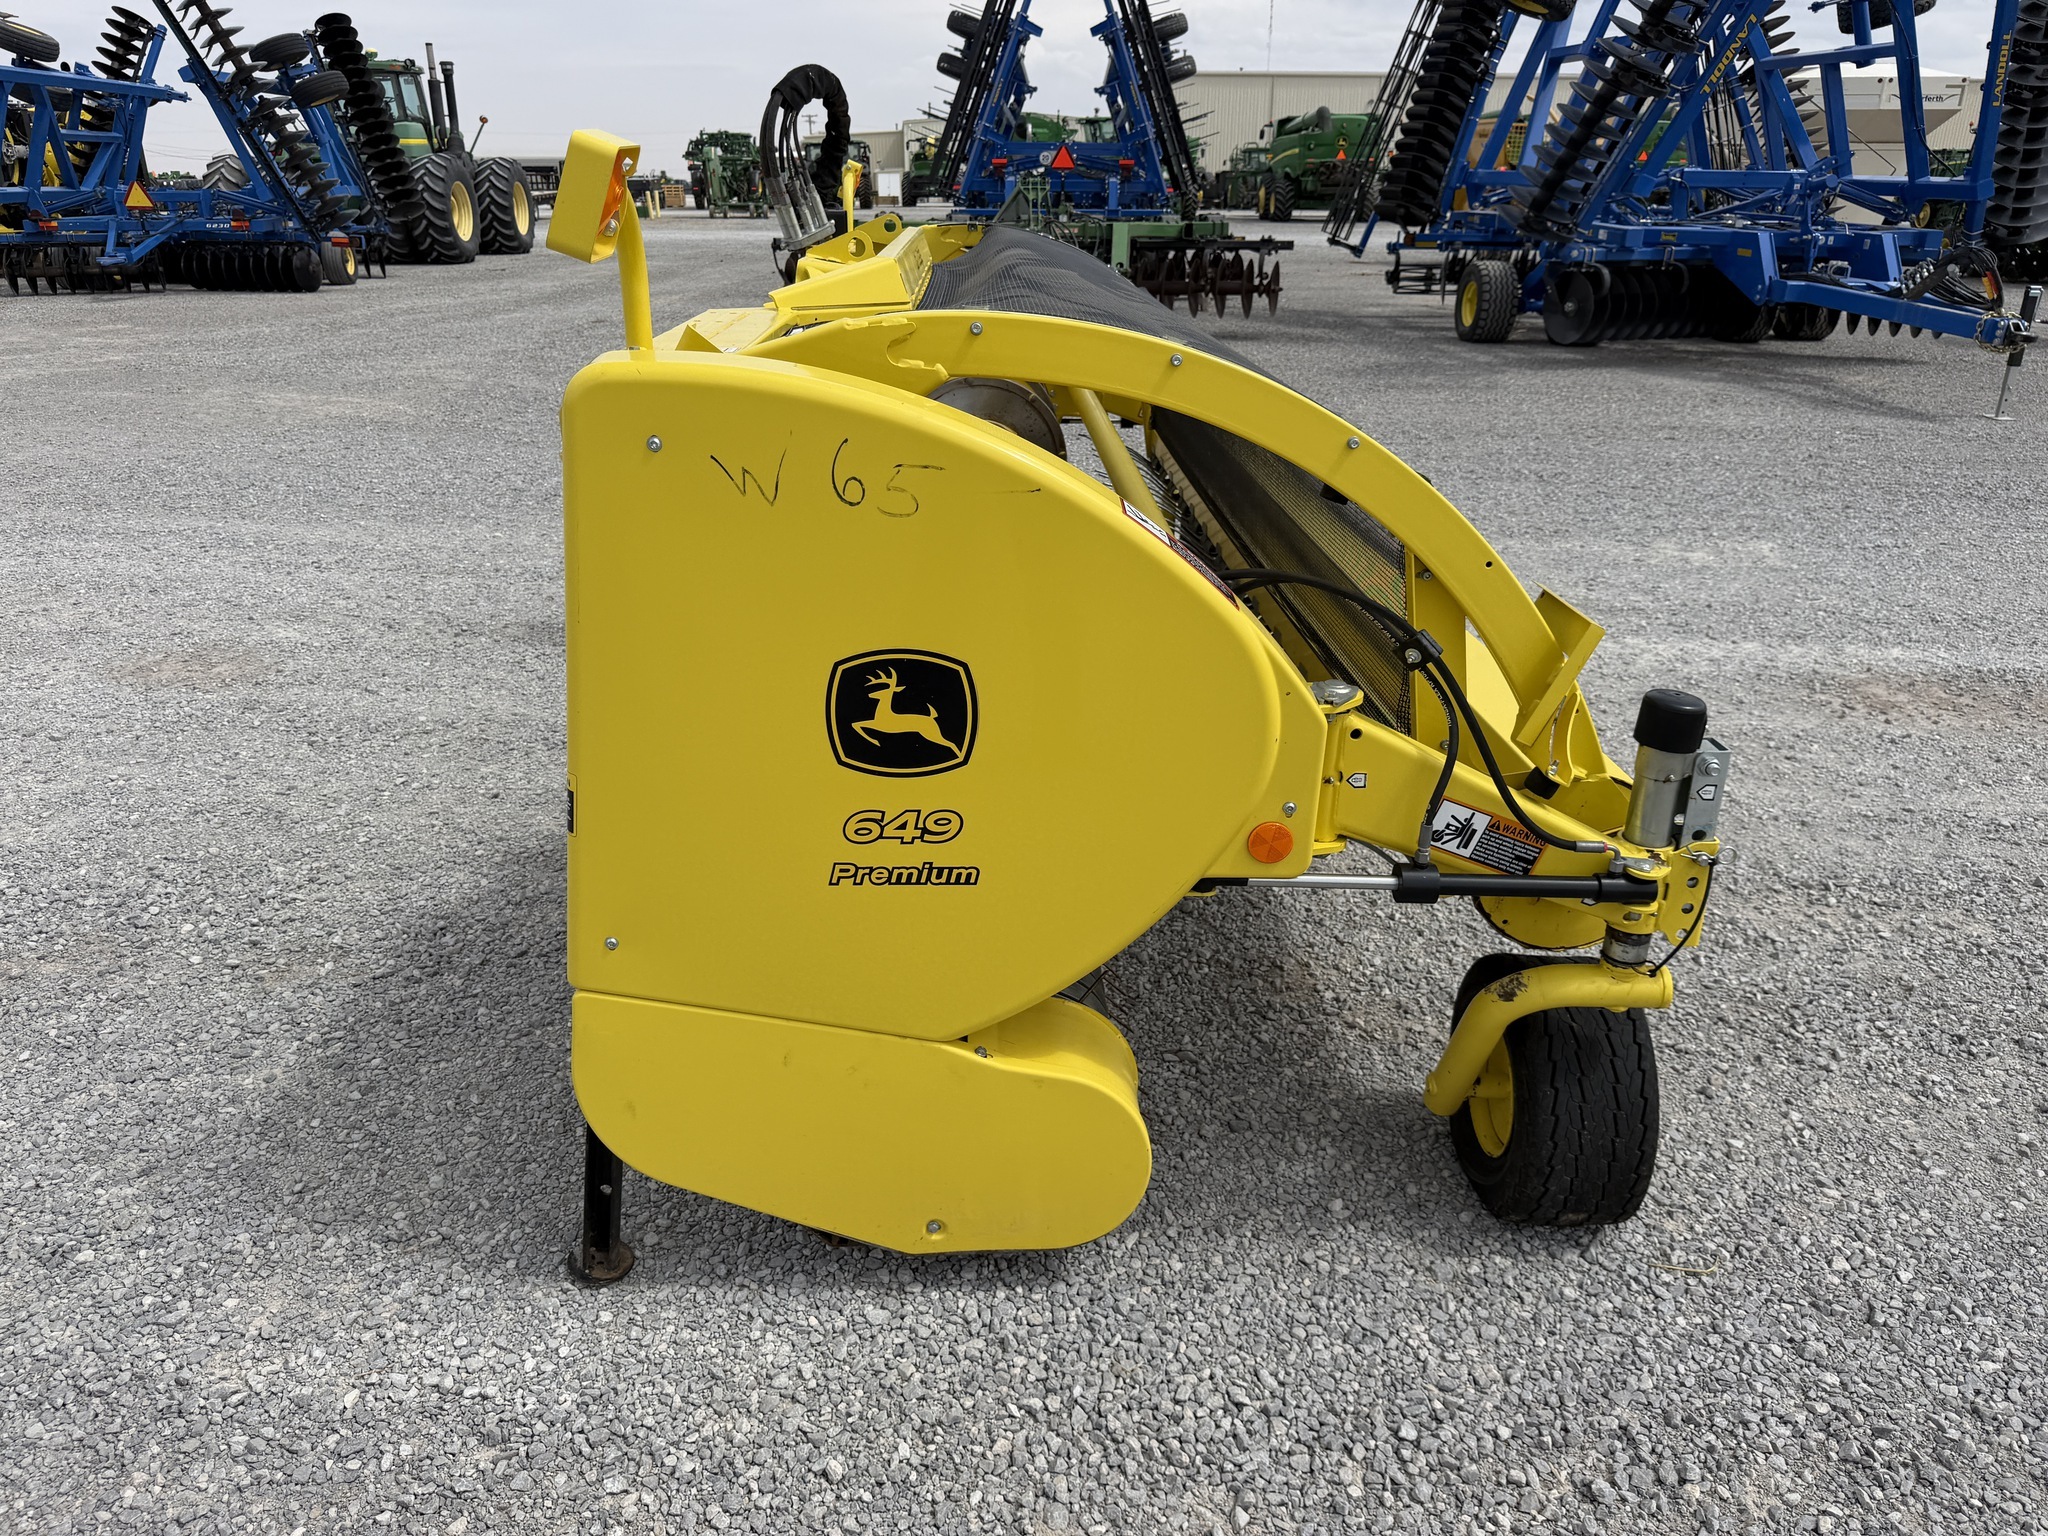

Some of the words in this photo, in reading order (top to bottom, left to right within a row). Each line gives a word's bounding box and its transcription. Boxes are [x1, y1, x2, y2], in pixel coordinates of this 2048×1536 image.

[1700, 14, 1757, 93] LANDOLL
[1993, 30, 2011, 106] LANDOLL
[842, 809, 964, 845] 649
[1502, 823, 1546, 846] WARNING
[828, 861, 981, 887] Premium
